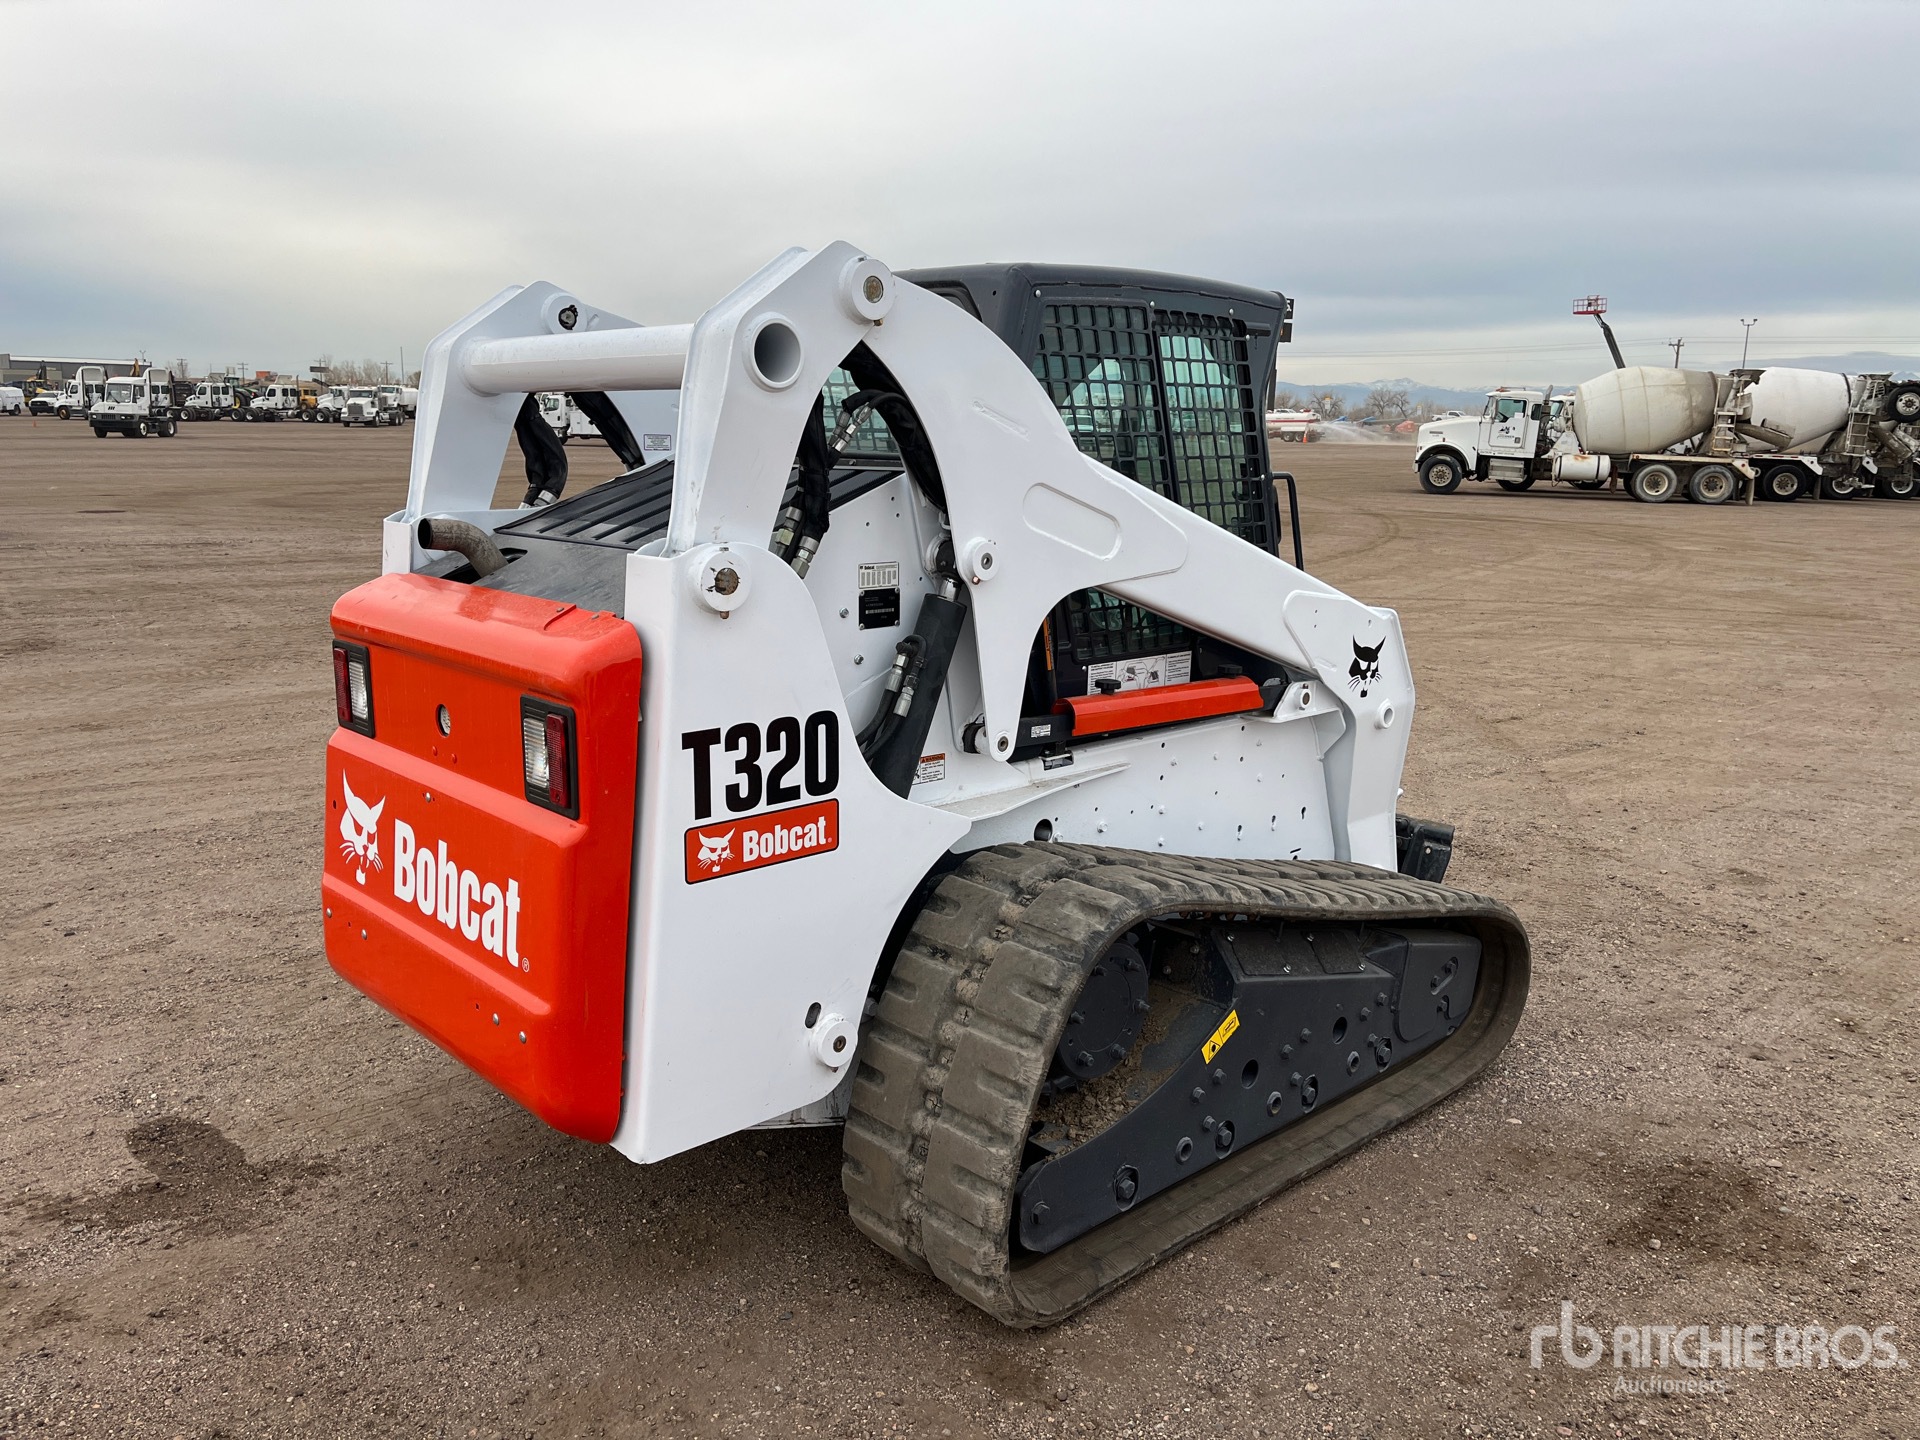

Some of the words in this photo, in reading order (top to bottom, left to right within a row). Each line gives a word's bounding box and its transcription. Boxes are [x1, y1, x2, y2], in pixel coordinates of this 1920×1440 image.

[681, 710, 840, 821] T320
[393, 818, 521, 968] Bobcat
[742, 816, 827, 863] Bobcat
